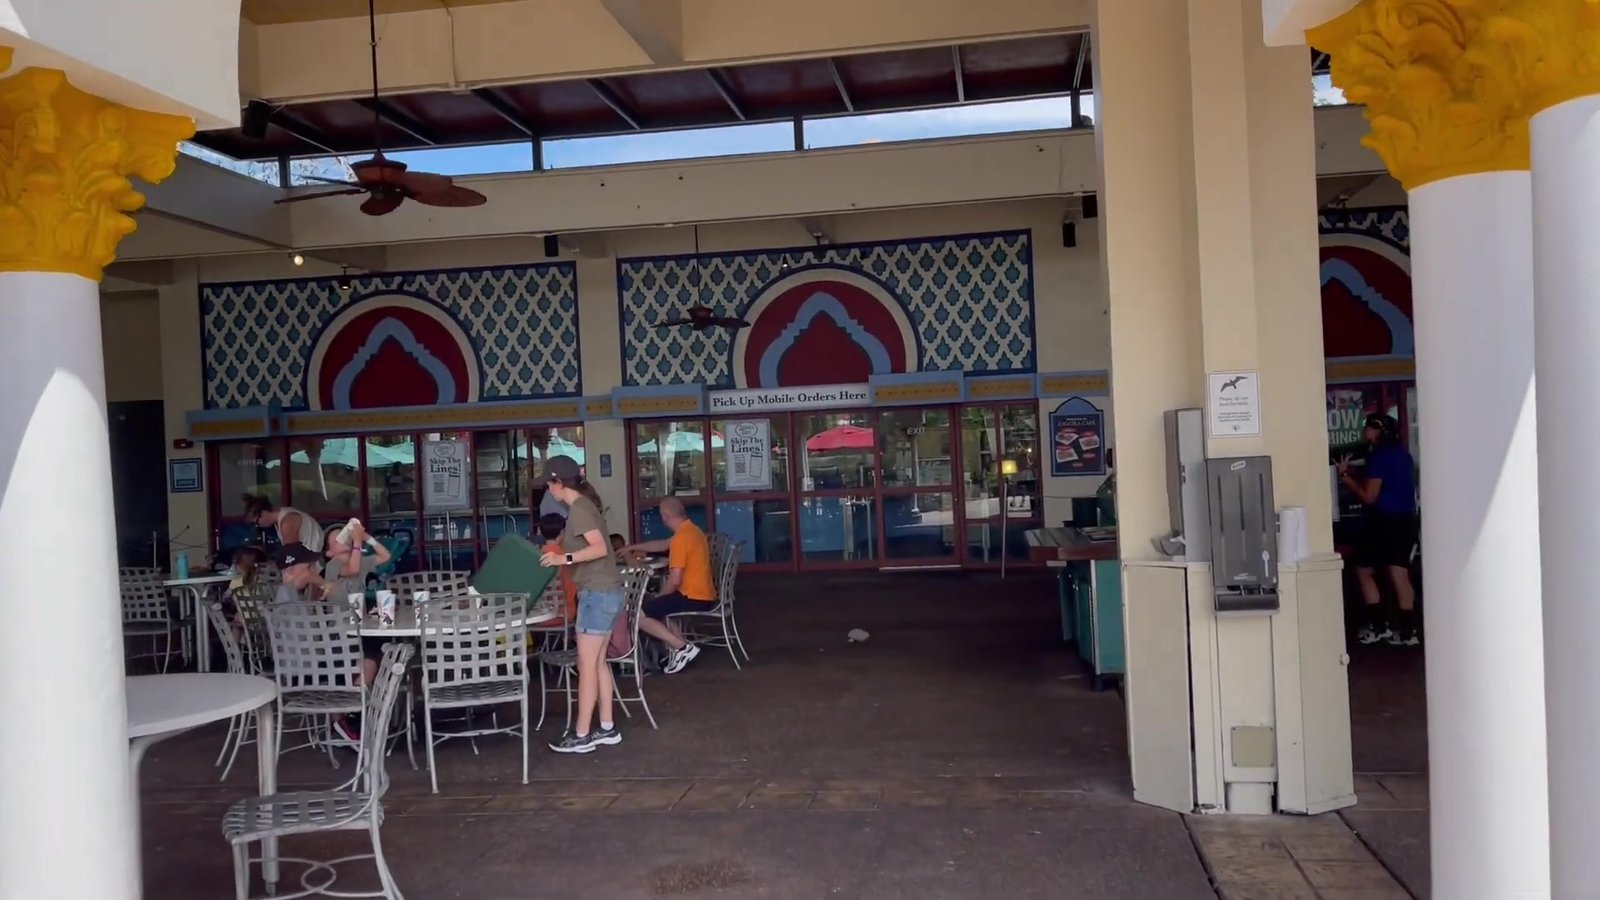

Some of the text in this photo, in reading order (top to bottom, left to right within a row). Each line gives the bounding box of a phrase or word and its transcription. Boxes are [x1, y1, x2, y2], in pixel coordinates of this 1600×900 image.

[713, 390, 867, 407] Pick Up Mobile Orders Here
[1328, 408, 1360, 430] OW
[907, 427, 925, 436] EXIT
[731, 437, 748, 446] Skip
[731, 443, 764, 453] Lines!
[429, 458, 446, 466] Skip
[430, 463, 461, 473] Lines!
